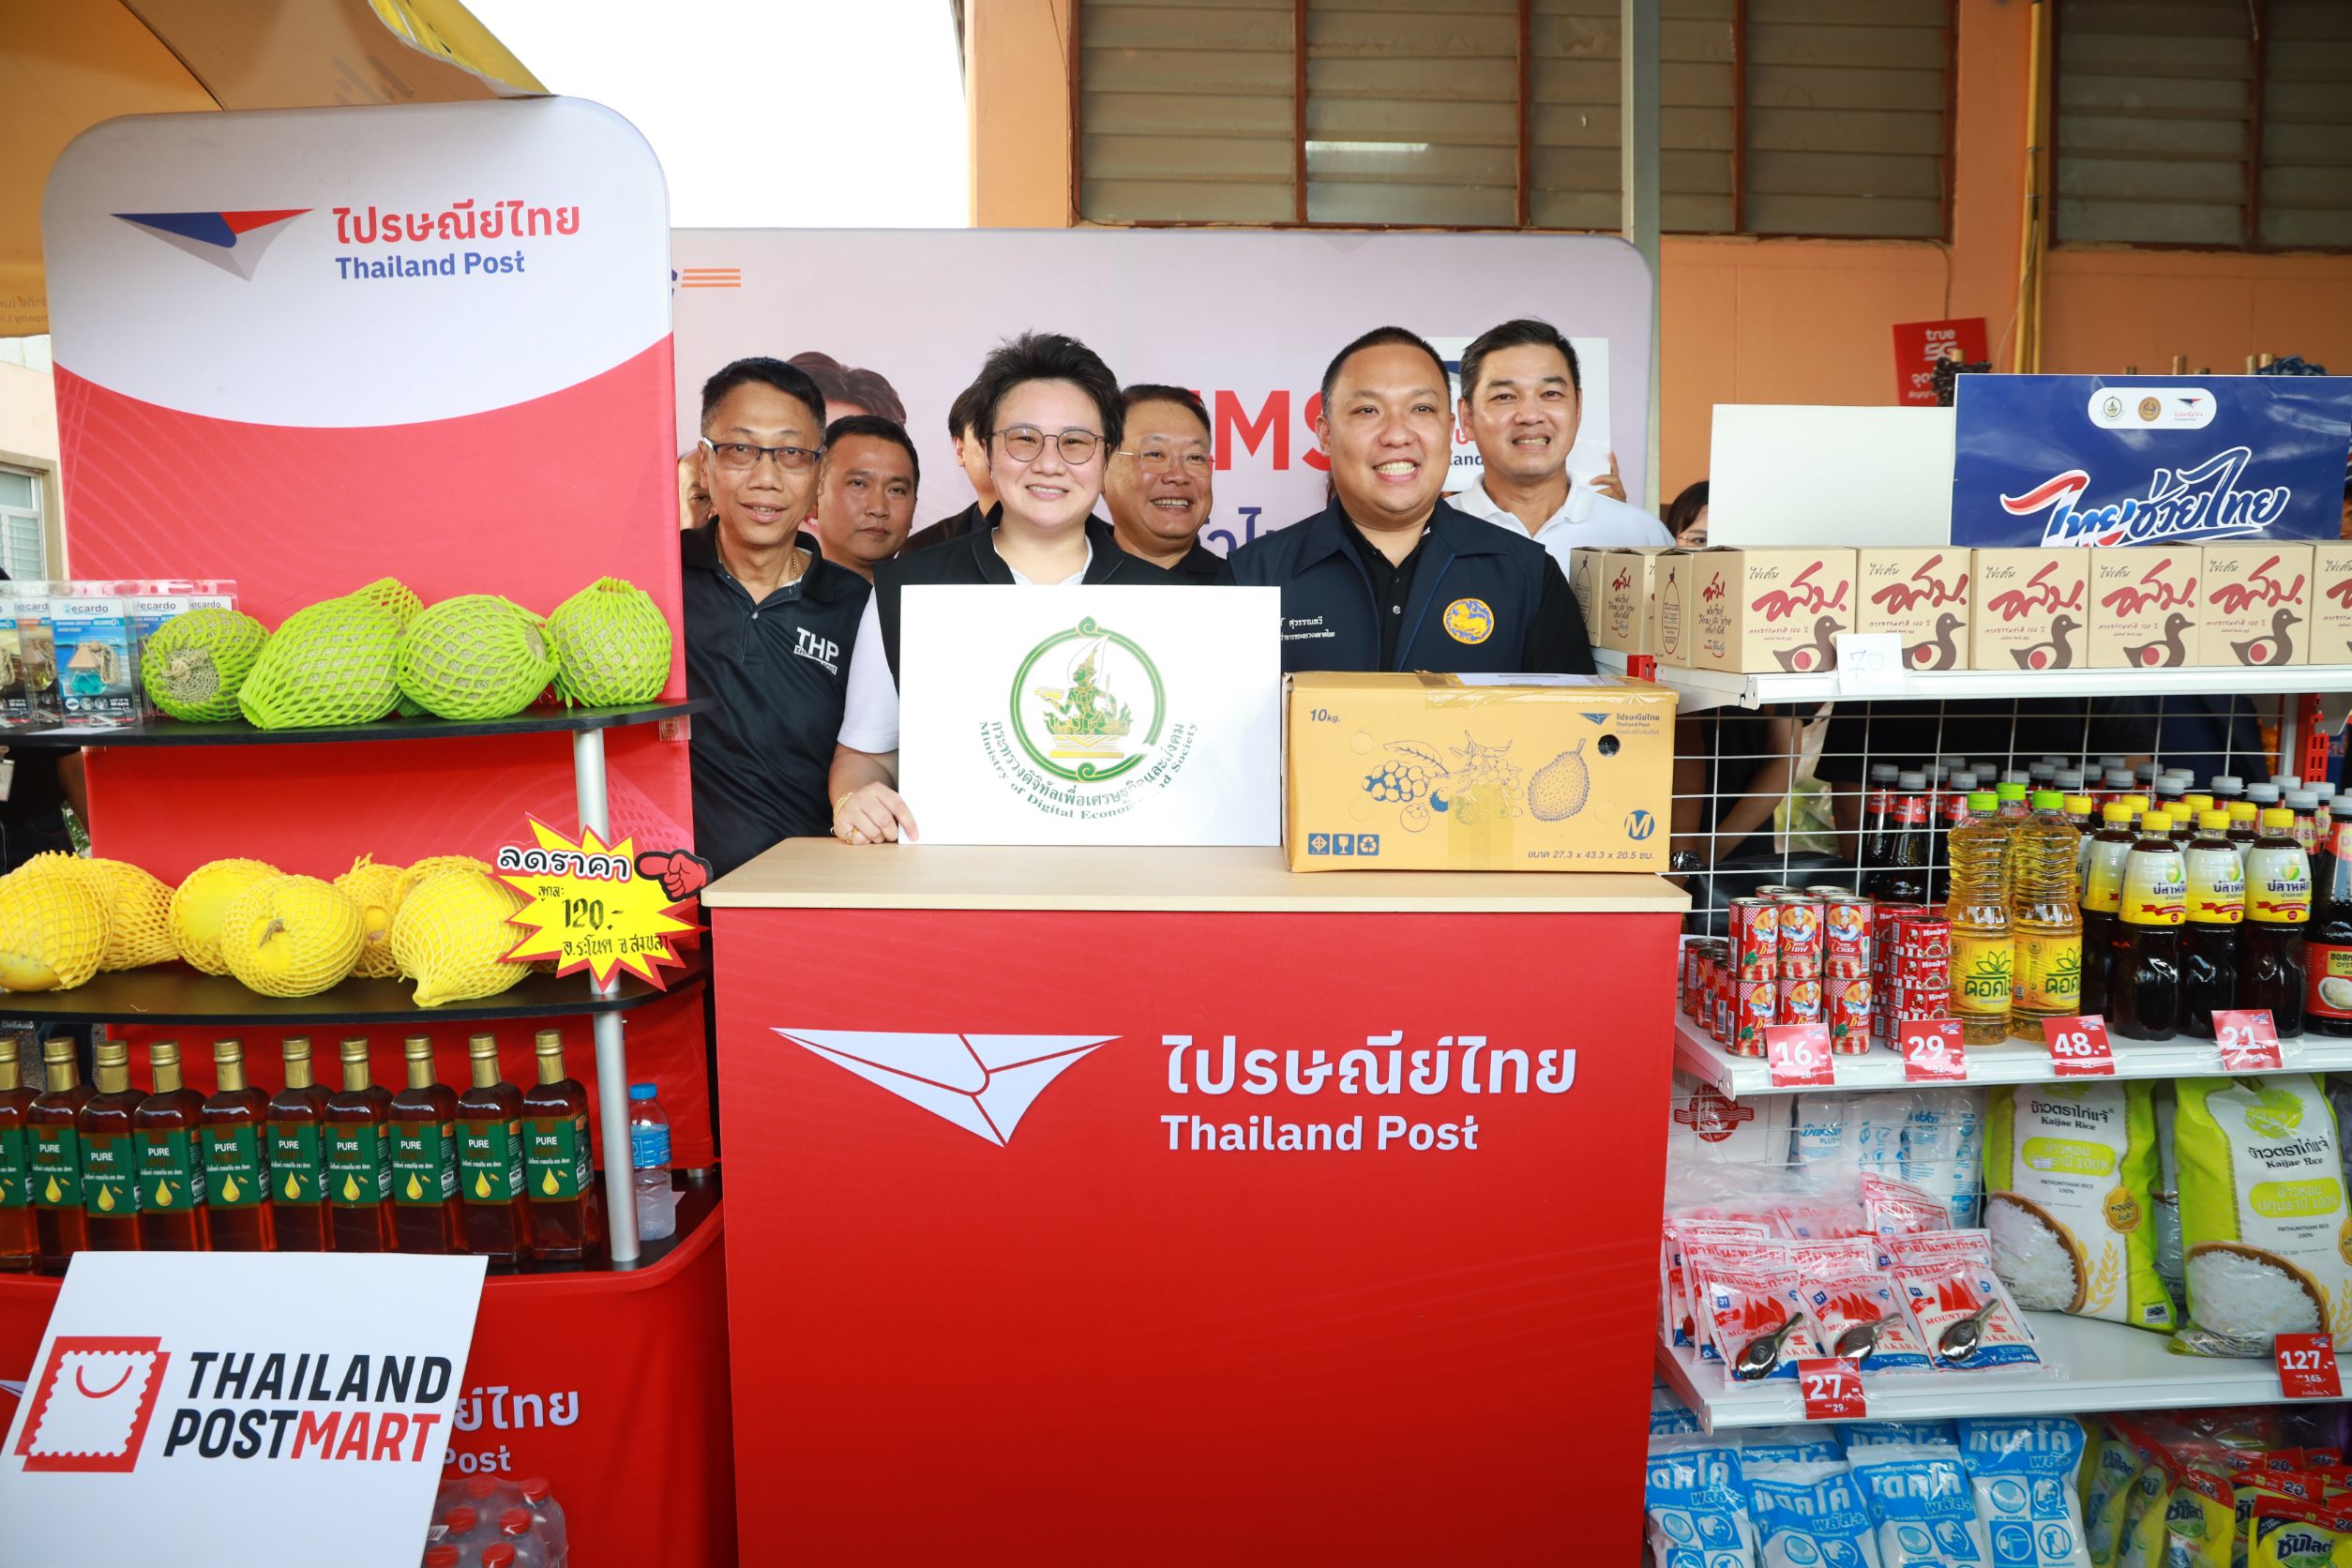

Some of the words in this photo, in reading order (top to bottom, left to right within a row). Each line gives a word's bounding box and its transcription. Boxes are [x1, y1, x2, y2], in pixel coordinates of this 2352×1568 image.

[332, 198, 580, 245] ไปรษณีย์ไทย
[335, 252, 456, 280] Thailand
[463, 249, 525, 276] Post
[1924, 328, 1956, 341] true
[1749, 565, 1780, 580] ไข่เค็ม
[1868, 563, 1900, 577] ไข่เค็ม
[1984, 565, 2016, 580] ไข่เค็ม
[2100, 565, 2131, 579] ไข่เค็ม
[2209, 560, 2239, 573] ไข่เค็ม
[190, 600, 221, 609] ecardo
[2027, 626, 2039, 634] 100
[795, 626, 840, 662] THP
[1309, 708, 1341, 724] 10kg.
[978, 721, 1009, 780] Ministry
[1010, 782, 1026, 795] of
[1025, 793, 1074, 819] Digital
[1171, 721, 1199, 773] Society
[1623, 813, 1653, 837] M
[1528, 850, 1550, 859] ขนาด
[1552, 850, 1574, 859] 27.3
[1584, 851, 1605, 859] 43.3
[1616, 851, 1636, 860] 20.5
[499, 847, 628, 880] ลดราคา
[562, 897, 626, 931] 120.-
[2054, 1032, 2107, 1057] 48.-
[1774, 1040, 1828, 1066] 16.-
[1162, 1030, 1577, 1094] ไปรษณีย์ไทย
[2030, 1099, 2109, 1123] ข้าวตราไก่แจ้
[2041, 1116, 2072, 1127] Kaijae
[2074, 1119, 2097, 1131] Rice
[1160, 1114, 1363, 1151] Thailand
[1378, 1114, 1479, 1151] Post
[39, 1143, 61, 1153] PURE
[214, 1142, 238, 1153] PURE
[278, 1139, 300, 1150] PURE
[336, 1141, 359, 1151] PURE
[400, 1140, 422, 1150] PURE
[468, 1138, 490, 1149] PURE
[535, 1136, 558, 1146] PURE
[2247, 1135, 2331, 1159] ข้าวตราไก่แจ้
[90, 1152, 113, 1162] PURE
[147, 1147, 171, 1156] PURE
[2075, 1156, 2110, 1171] 100%
[2265, 1159, 2301, 1168] Kaijae
[2280, 1349, 2334, 1370] 127.-
[188, 1351, 453, 1404] THAILAND
[1806, 1374, 1860, 1400] 27.-
[455, 1385, 580, 1431] ย์ไทย
[162, 1409, 442, 1462] POSTMART
[2283, 1480, 2305, 1496] 20
